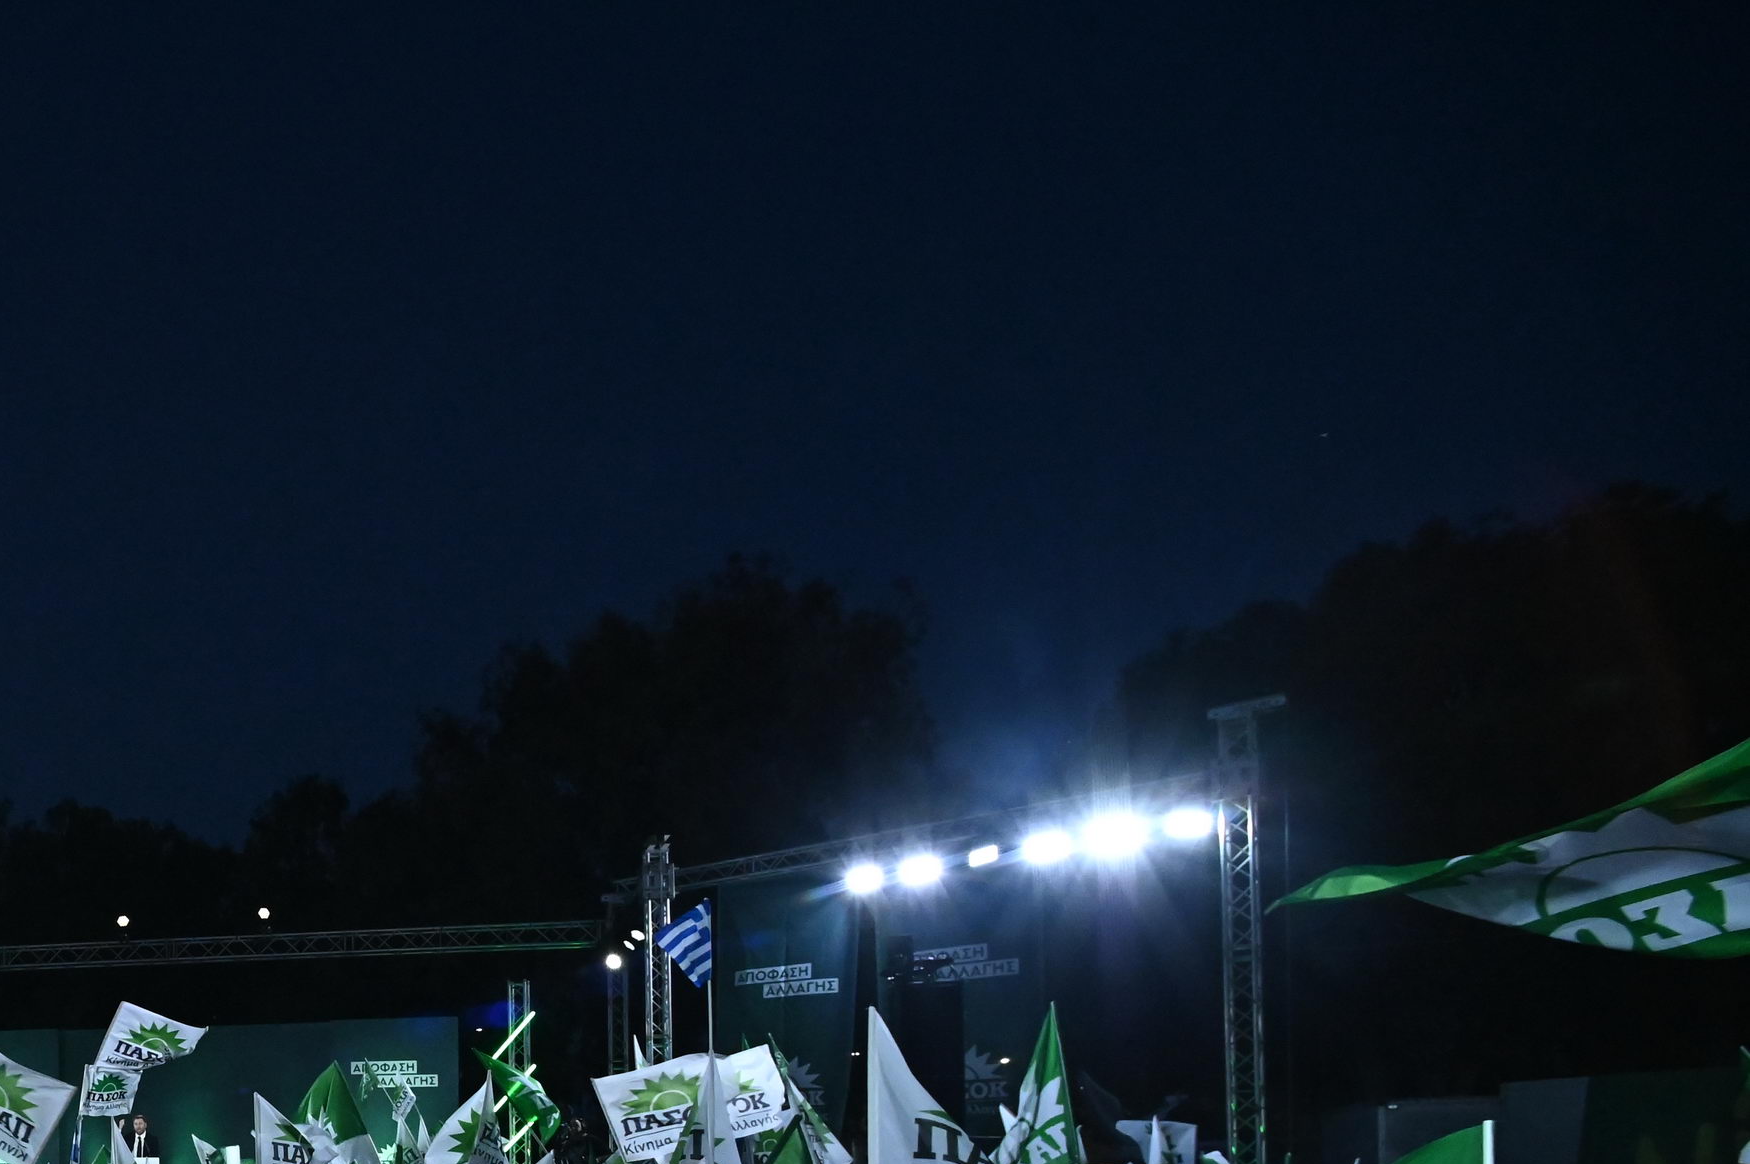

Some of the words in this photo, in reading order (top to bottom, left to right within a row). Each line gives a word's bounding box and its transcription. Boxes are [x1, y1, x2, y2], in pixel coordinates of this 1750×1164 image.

[737, 966, 809, 983] ΑΠΟΦΑΣΗ
[766, 980, 836, 996] ΑΛΛΑΓΗΣ
[114, 1040, 164, 1063] ΠΑΣ
[381, 1076, 437, 1086] ΑΛΑΓΗΣ
[87, 1091, 128, 1102] ΠΑΣΟΚ
[623, 1136, 673, 1155] Κίνημα
